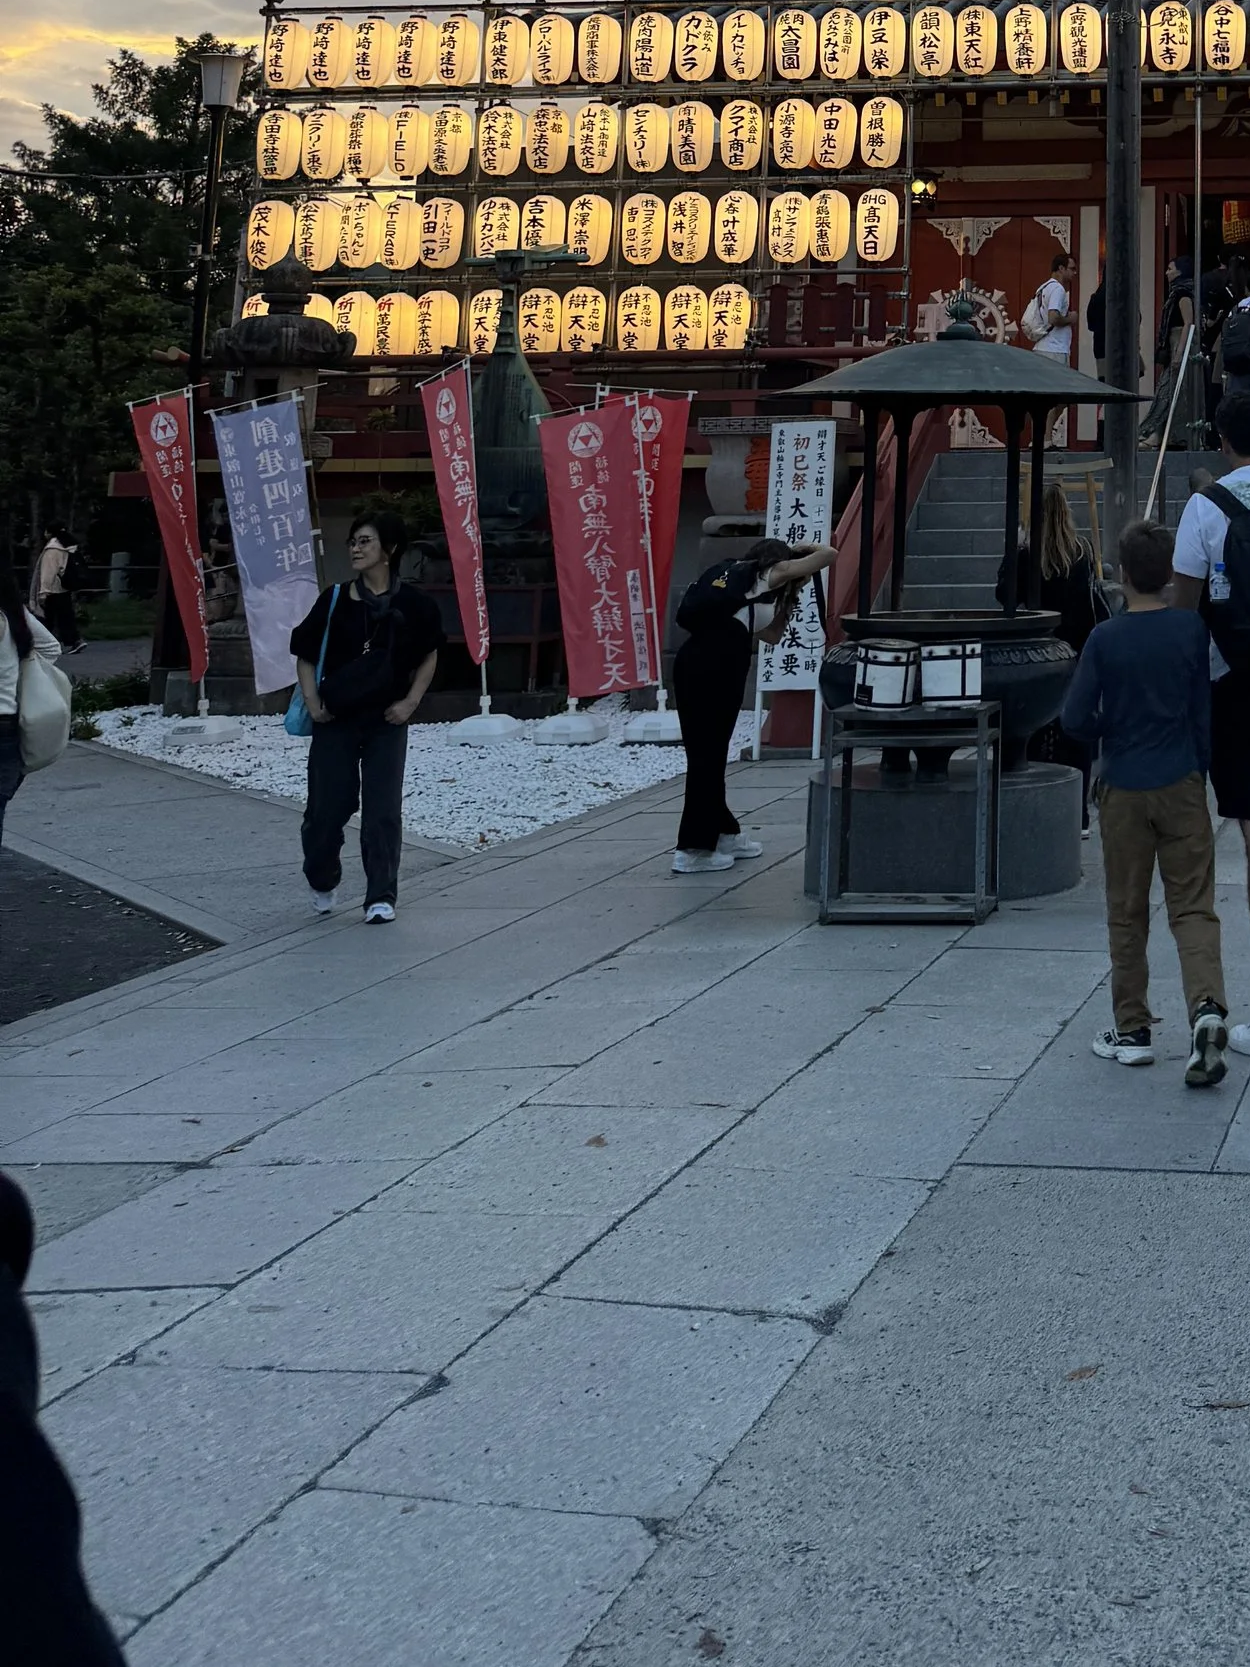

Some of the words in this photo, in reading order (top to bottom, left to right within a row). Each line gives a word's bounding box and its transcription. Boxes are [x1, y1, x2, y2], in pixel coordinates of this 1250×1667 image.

[491, 18, 512, 80] 伊東健太郎
[635, 15, 657, 77] 焼肉陽山道
[681, 15, 703, 72] カドクラ
[1213, 4, 1234, 66] 谷中七福神
[482, 111, 502, 171] 鈴木法衣店
[550, 110, 563, 134] 京都
[728, 104, 746, 166] クマイ商店
[819, 102, 842, 164] 中田光広
[866, 101, 887, 162] 曽根勝人
[422, 204, 438, 262] 引田一史
[480, 199, 496, 256] ゆずカンパニ
[524, 199, 548, 247] 吉本優
